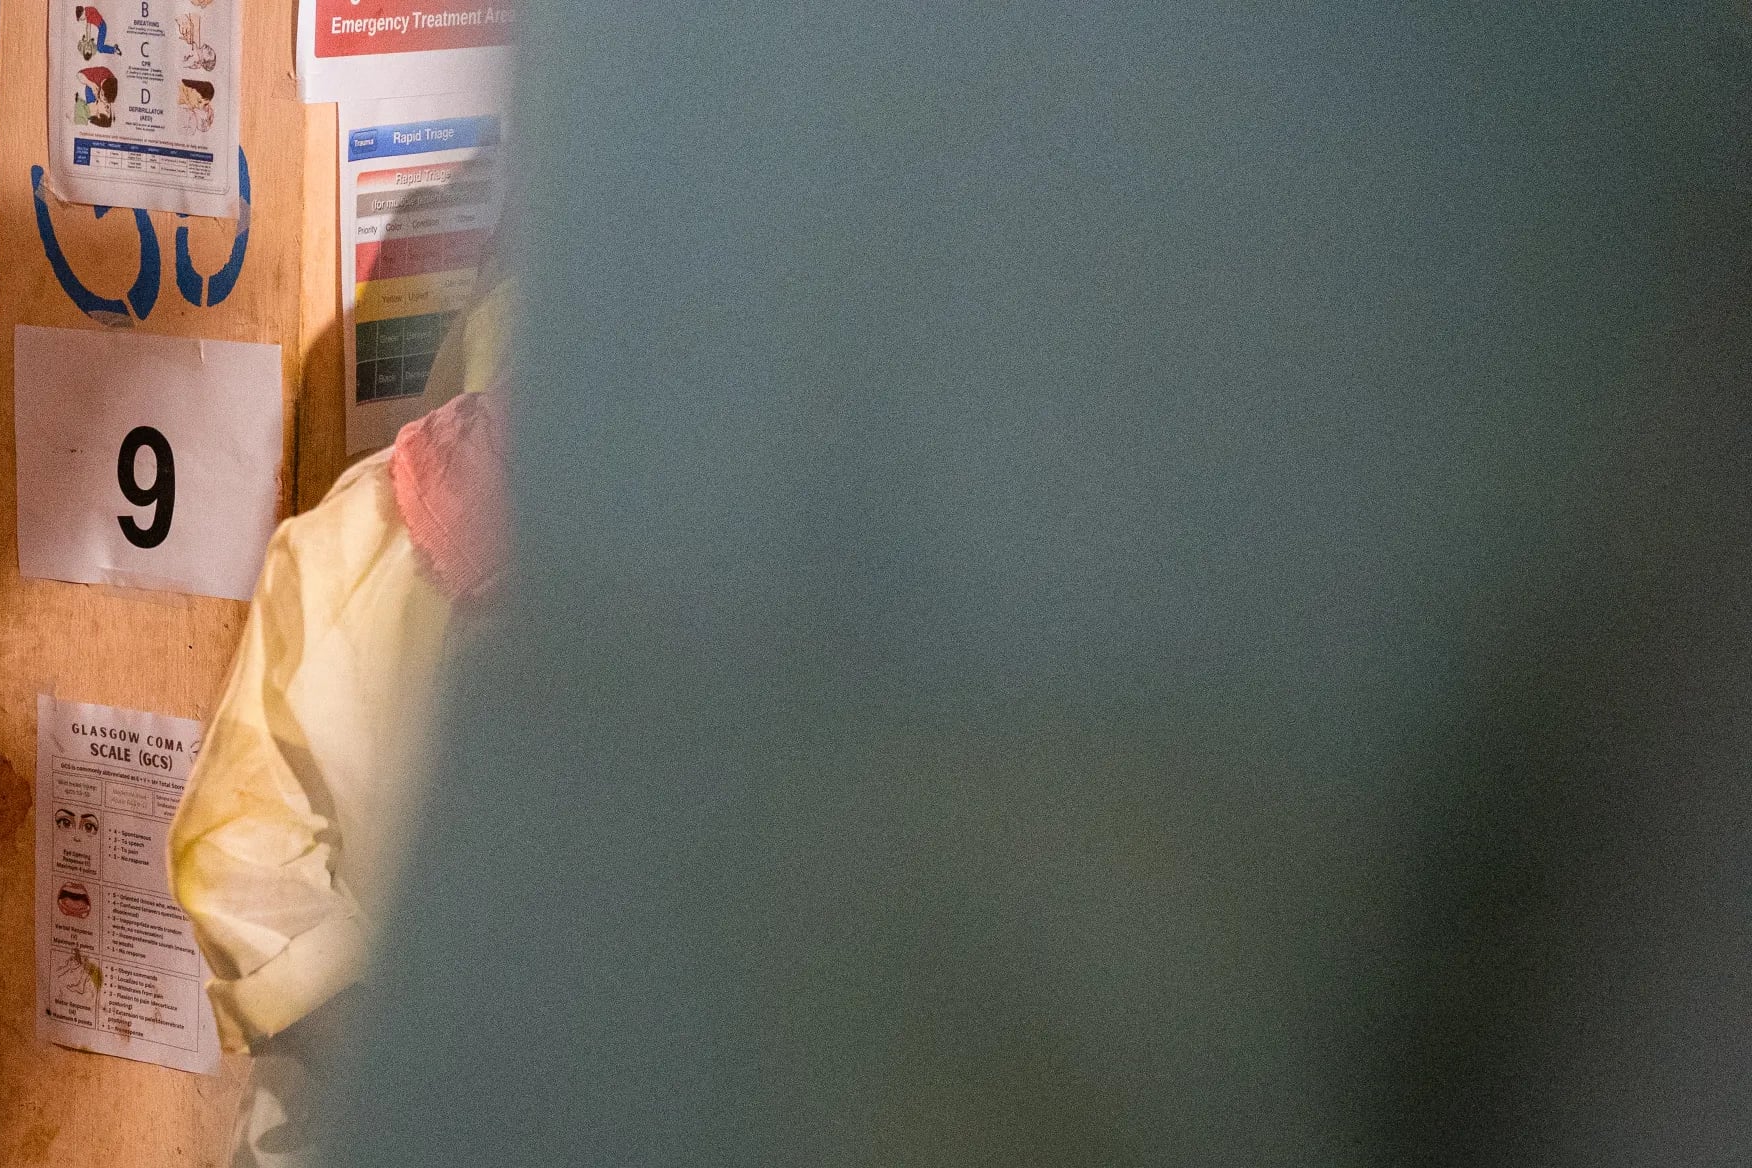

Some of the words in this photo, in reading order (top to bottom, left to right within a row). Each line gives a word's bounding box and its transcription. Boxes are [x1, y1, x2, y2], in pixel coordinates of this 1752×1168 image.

[141, 2, 149, 17] B
[134, 20, 160, 28] BREATHING
[331, 15, 409, 37] Emergency
[412, 9, 482, 29] Treatment
[140, 42, 149, 57] C
[141, 88, 150, 104] D
[354, 139, 374, 147] Trauma
[393, 131, 422, 146] Rapid
[424, 128, 455, 141] Triage
[396, 172, 422, 185] Rapid
[424, 168, 452, 183] Triage
[372, 200, 385, 211] (for
[358, 226, 378, 237] Priority
[385, 222, 404, 232] Color
[116, 426, 176, 550] 9
[72, 723, 140, 744] GLASGOW
[147, 735, 184, 752] COMA
[90, 742, 131, 762] SCALE
[138, 749, 173, 772] (GCS)
[76, 766, 102, 776] commonly
[102, 770, 130, 780] abbreviated
